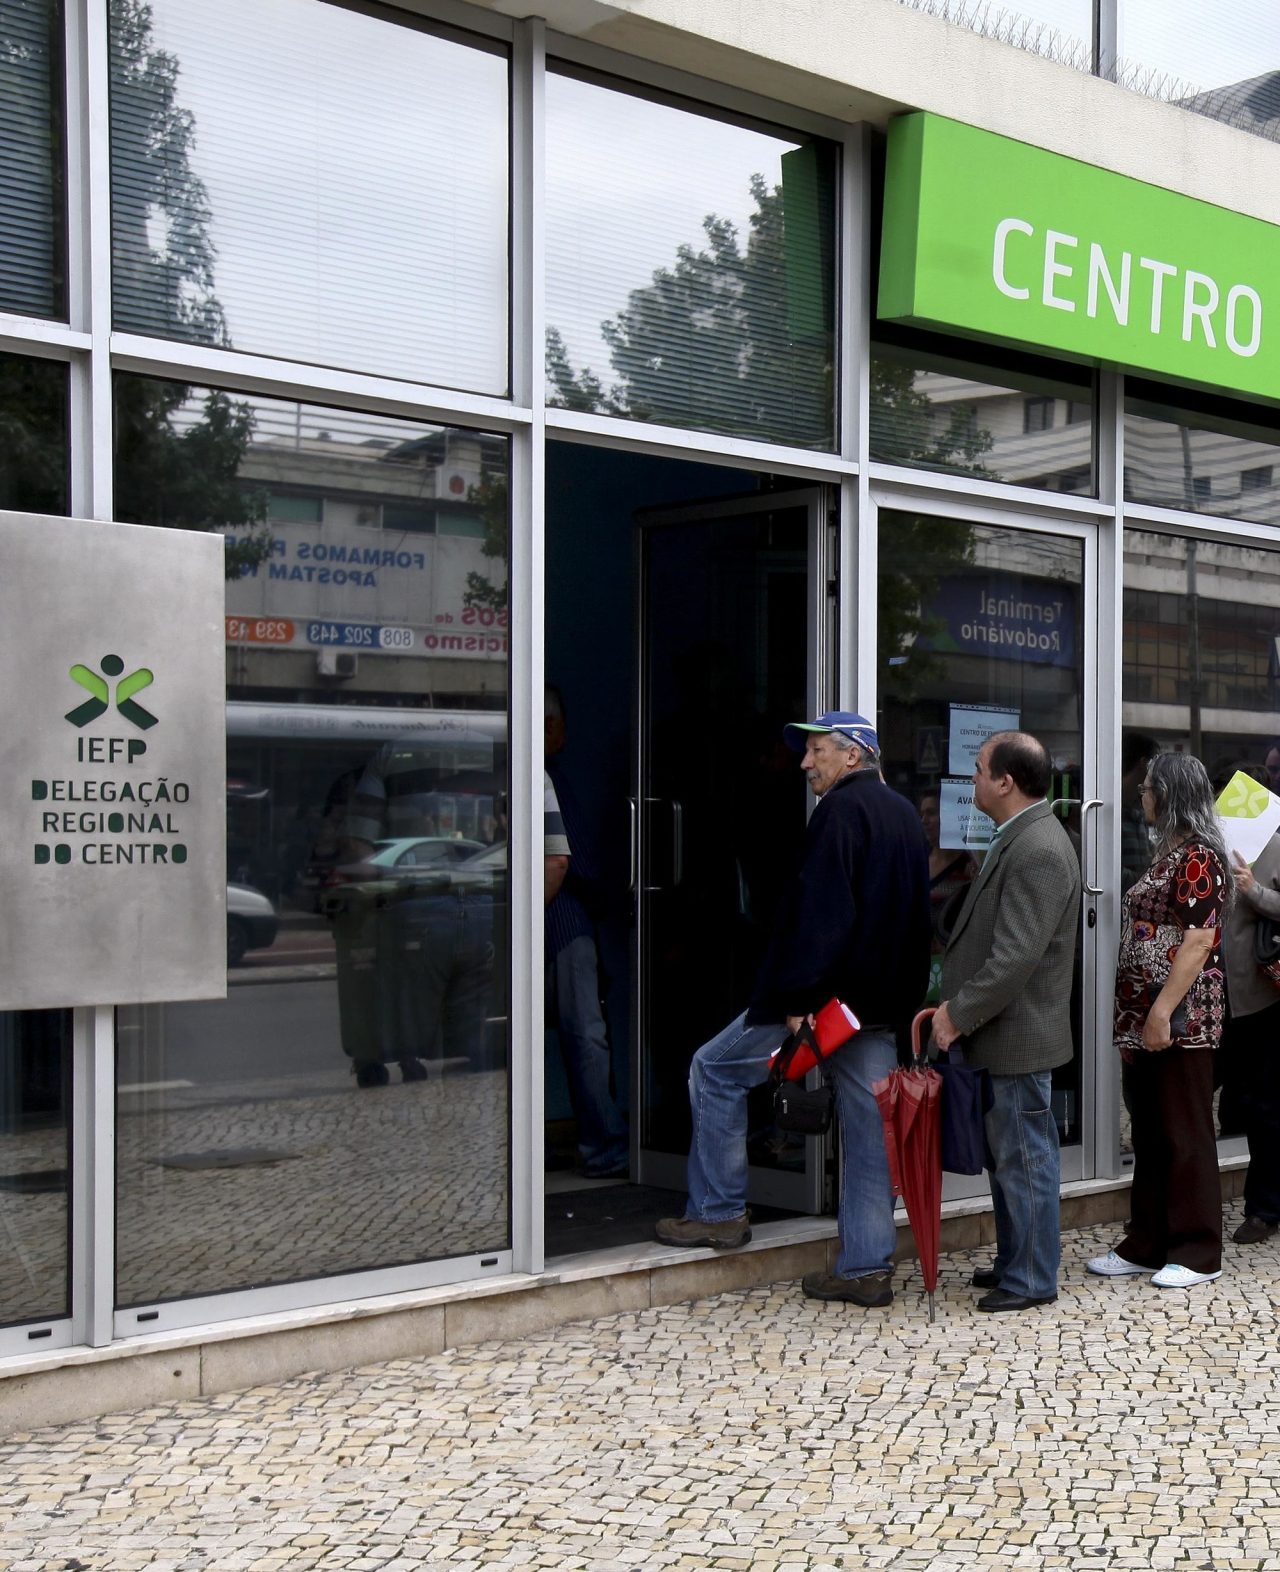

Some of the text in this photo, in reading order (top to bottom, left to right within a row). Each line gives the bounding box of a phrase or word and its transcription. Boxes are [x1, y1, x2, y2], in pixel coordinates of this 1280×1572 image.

[993, 218, 1262, 358] CENTRO
[76, 736, 148, 764] IEFP
[31, 777, 190, 807] DELEGAÇÃO
[42, 812, 179, 834] REGIONAL
[34, 843, 188, 865] DO CENTRO
